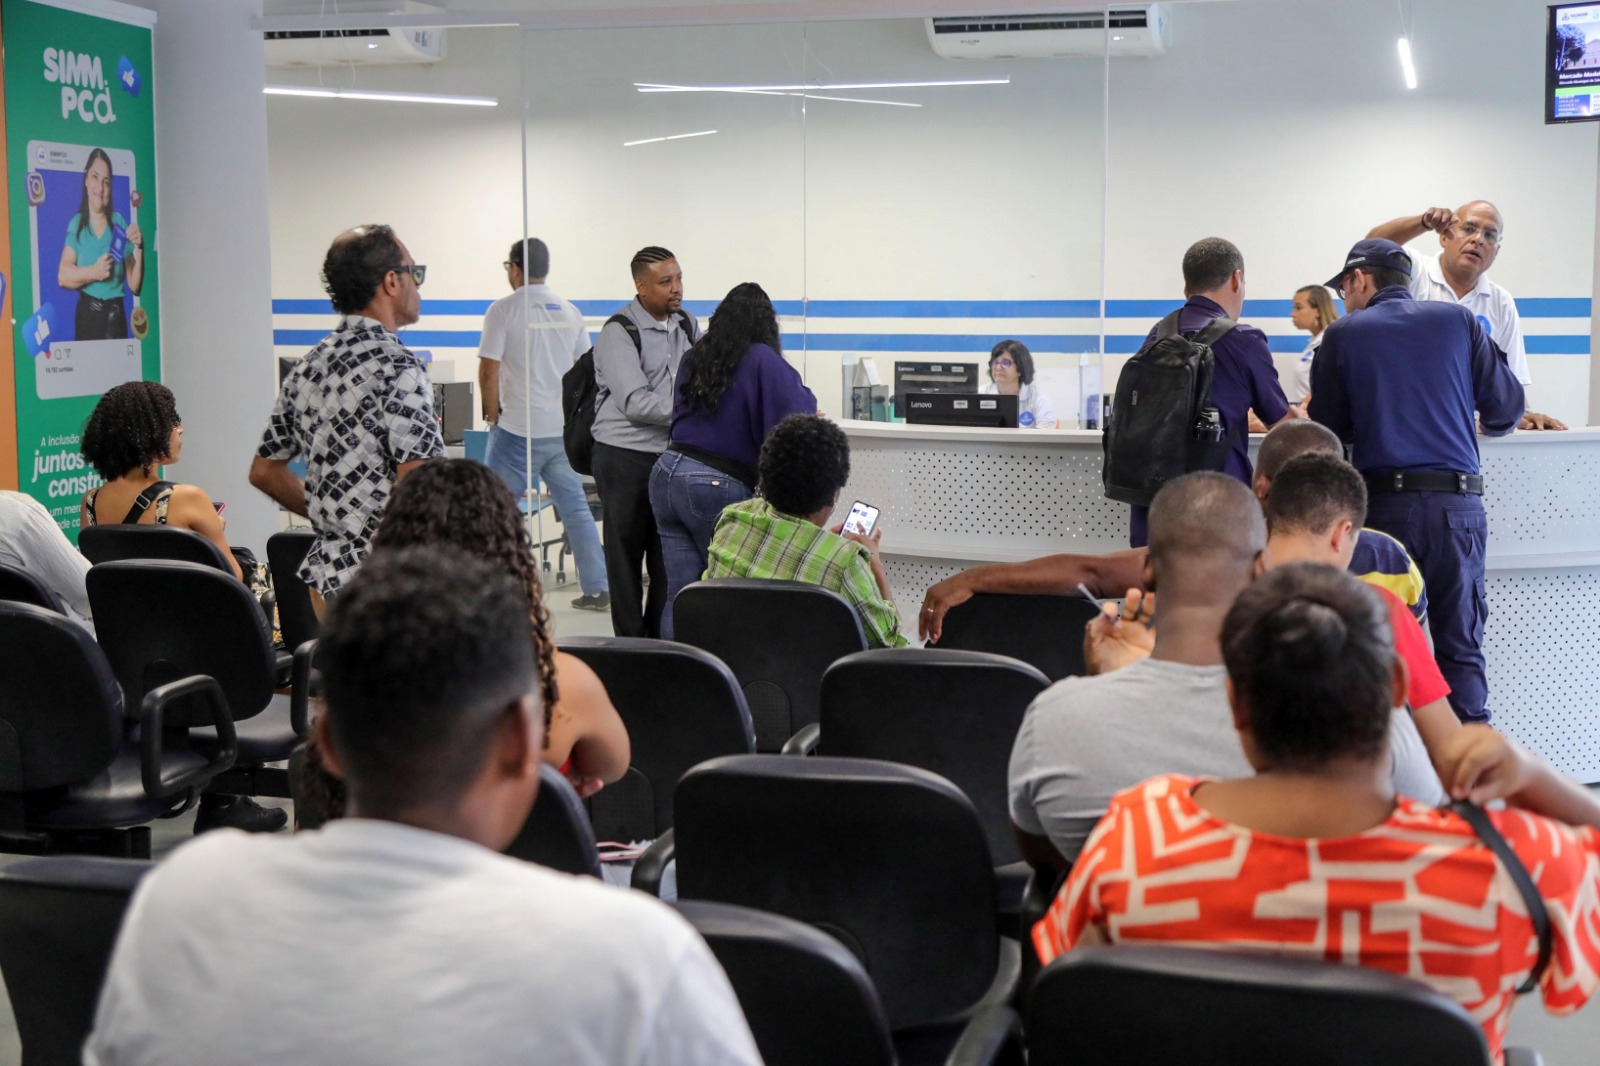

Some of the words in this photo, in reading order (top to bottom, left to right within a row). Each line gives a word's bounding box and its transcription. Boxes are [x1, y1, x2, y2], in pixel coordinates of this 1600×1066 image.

[911, 401, 932, 409] Lenovo
[41, 437, 46, 447] A
[48, 434, 80, 447] inclusão
[31, 450, 85, 484] juntos
